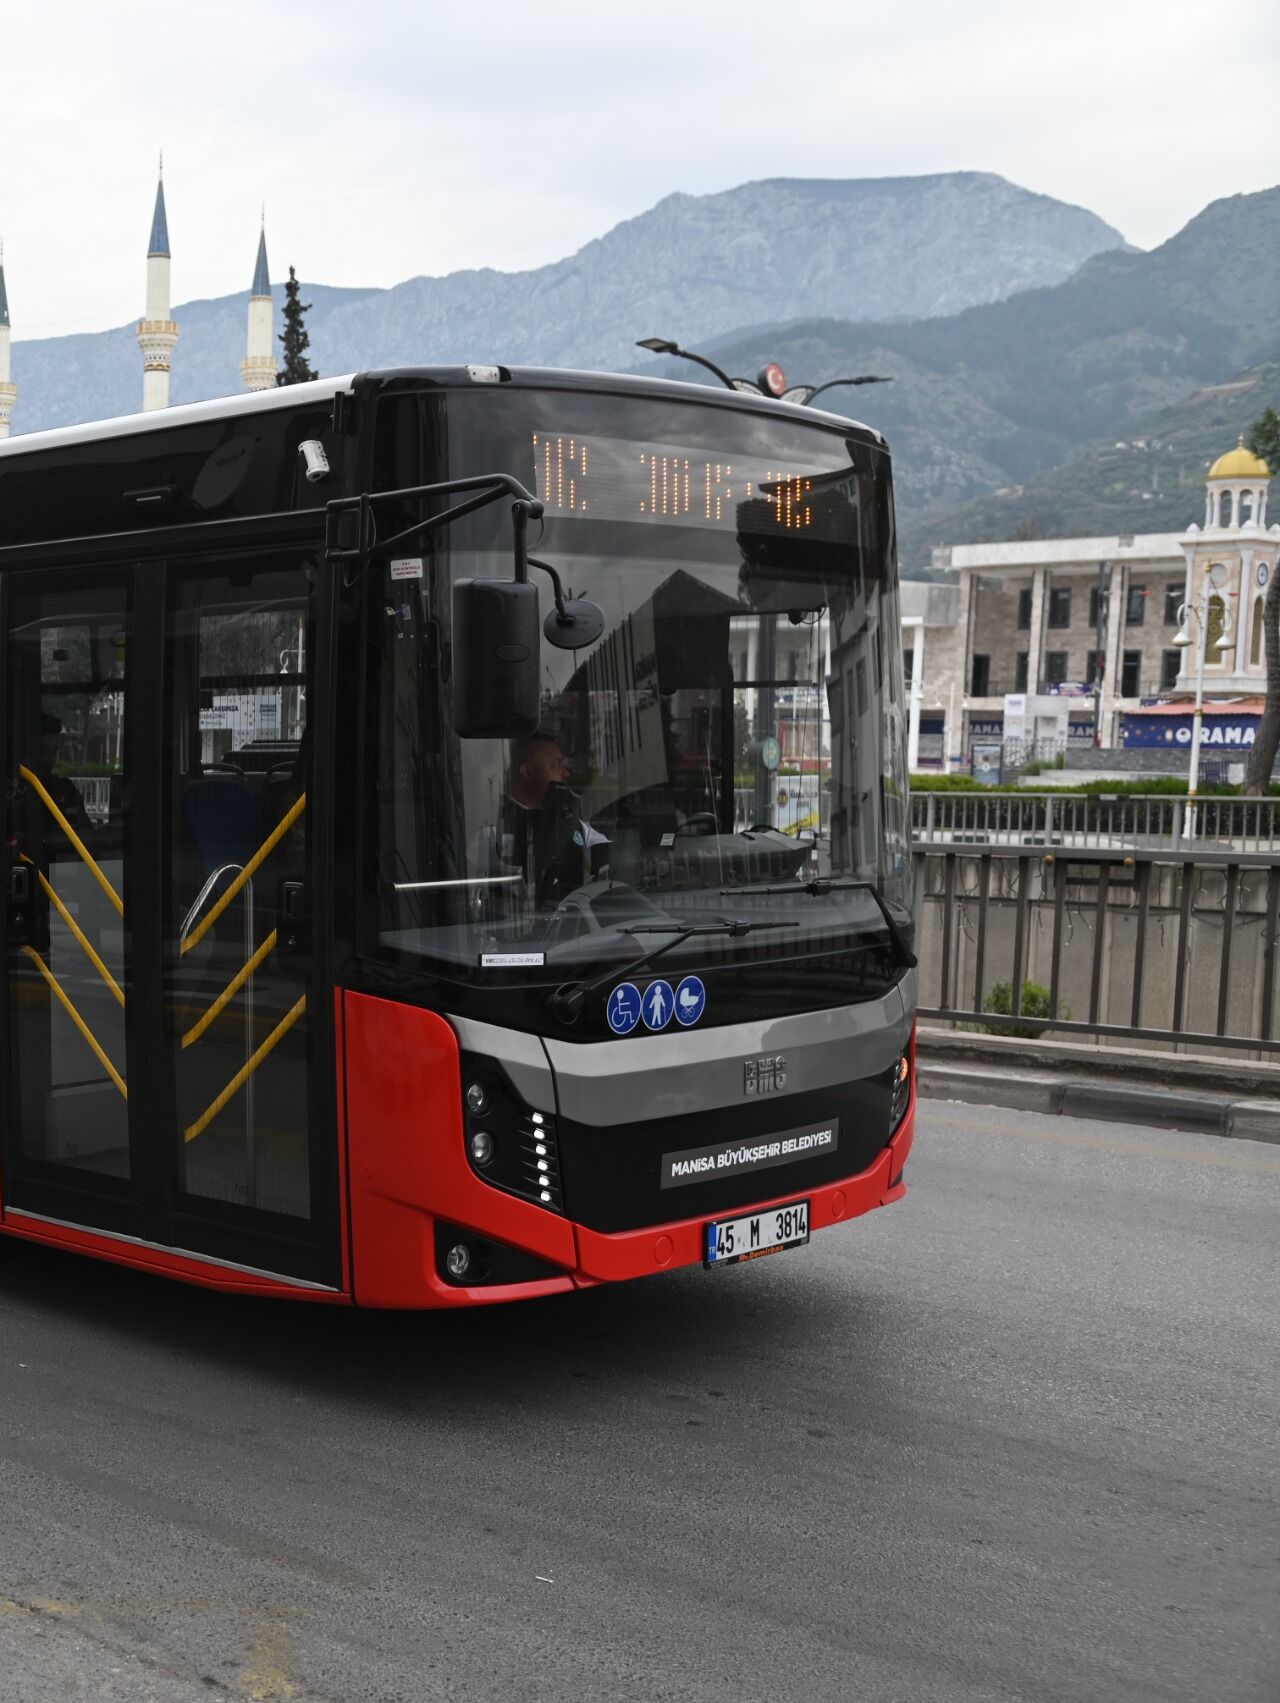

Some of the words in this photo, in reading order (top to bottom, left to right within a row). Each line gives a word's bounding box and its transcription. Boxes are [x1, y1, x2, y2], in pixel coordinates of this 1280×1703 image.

[671, 1156, 715, 1177] MANİSA
[717, 1142, 781, 1163] BÜYÜKŞEHİR
[781, 1129, 833, 1155] BELEDİYESİ
[716, 1224, 735, 1256] 45
[750, 1218, 760, 1248] M
[775, 1207, 807, 1241] 3814
